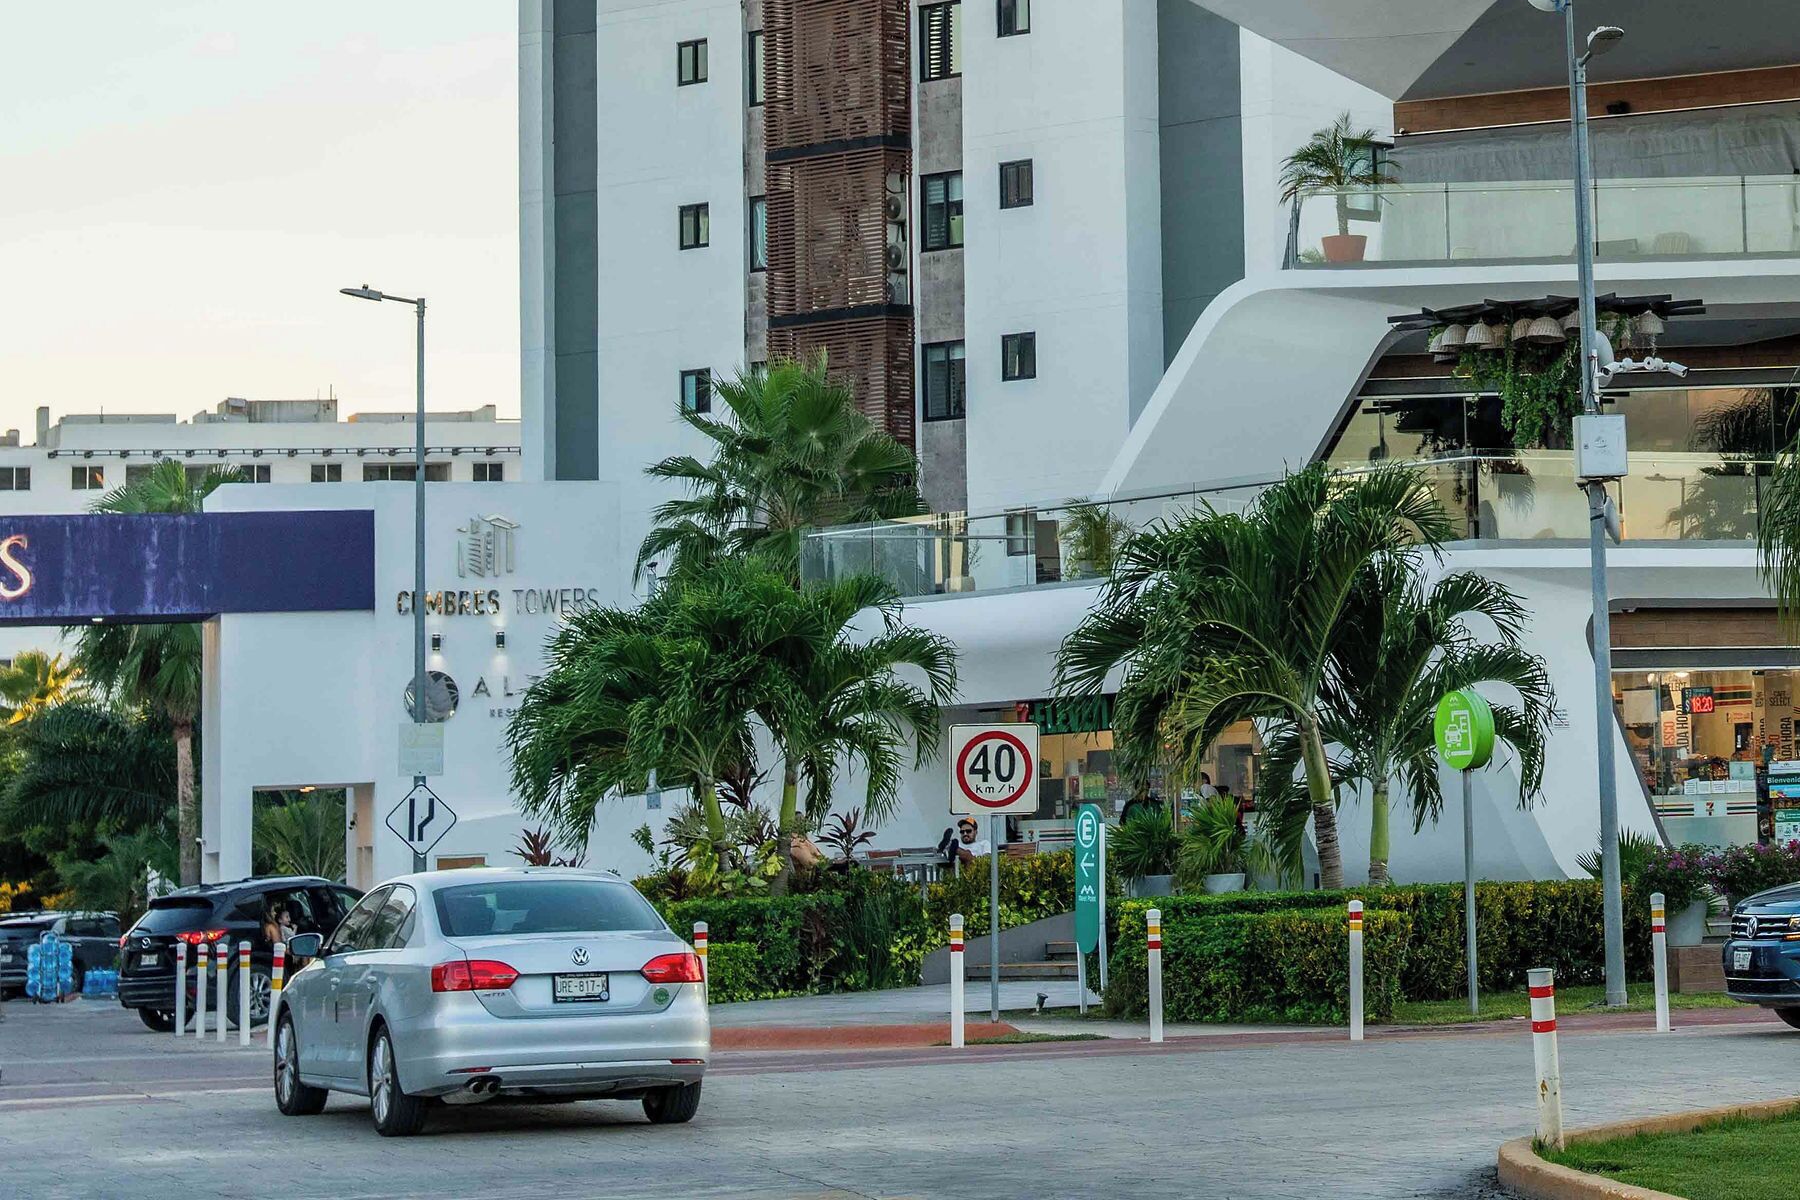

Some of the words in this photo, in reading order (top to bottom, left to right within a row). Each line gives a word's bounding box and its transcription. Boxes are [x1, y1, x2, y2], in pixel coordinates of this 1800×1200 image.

[397, 590, 500, 616] CMBRES
[512, 588, 599, 615] TOWERS
[1663, 720, 1675, 748] ESCO
[1780, 715, 1793, 742] HORA
[968, 743, 1016, 783] 40
[975, 784, 1015, 794] km/h
[1082, 818, 1092, 841] E
